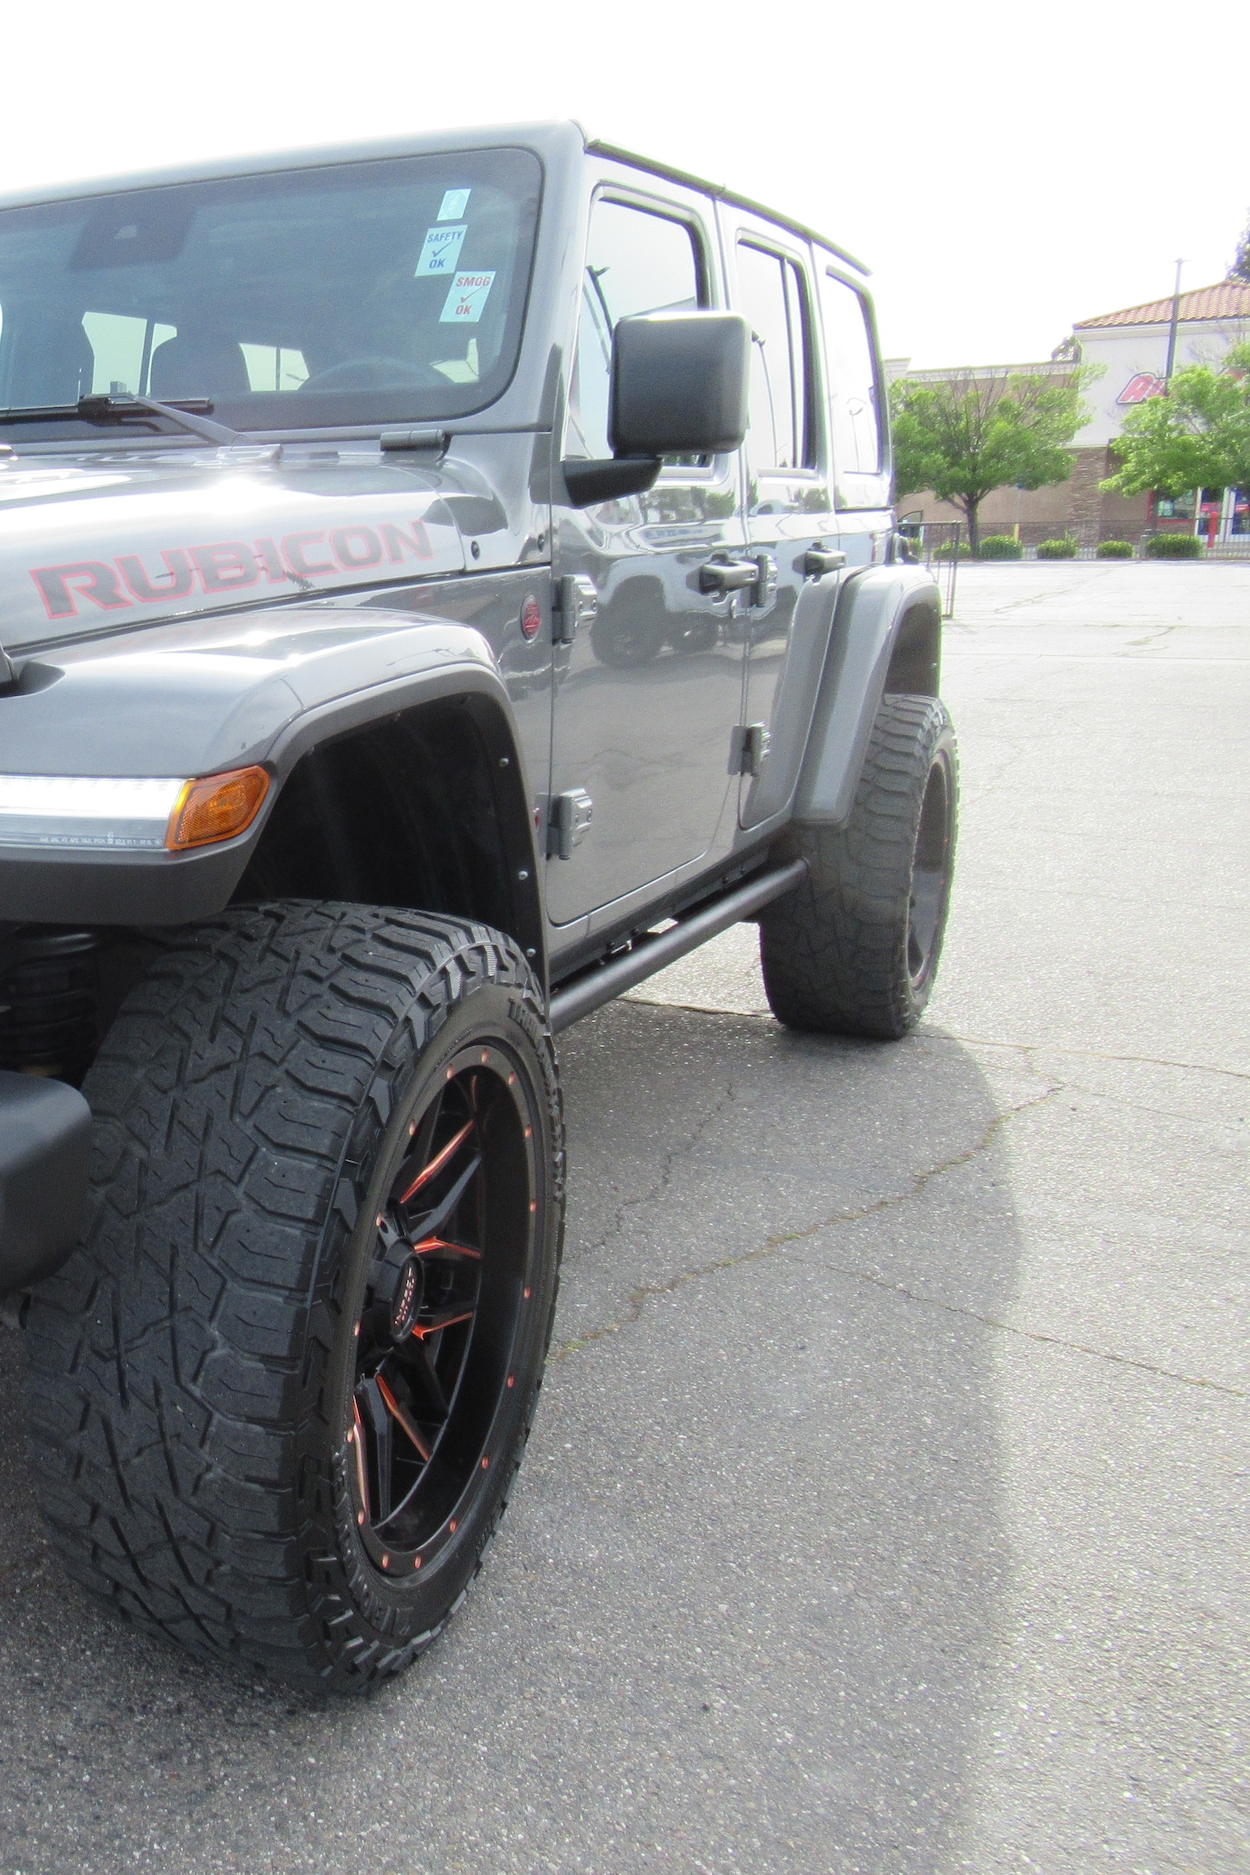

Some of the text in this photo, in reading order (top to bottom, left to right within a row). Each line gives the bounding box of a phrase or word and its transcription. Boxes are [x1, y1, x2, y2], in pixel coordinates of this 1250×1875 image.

[427, 230, 464, 243] SAFETY
[429, 258, 446, 269] OK
[456, 276, 491, 287] SMOG
[455, 304, 472, 315] OK
[28, 518, 435, 620] RUBICON
